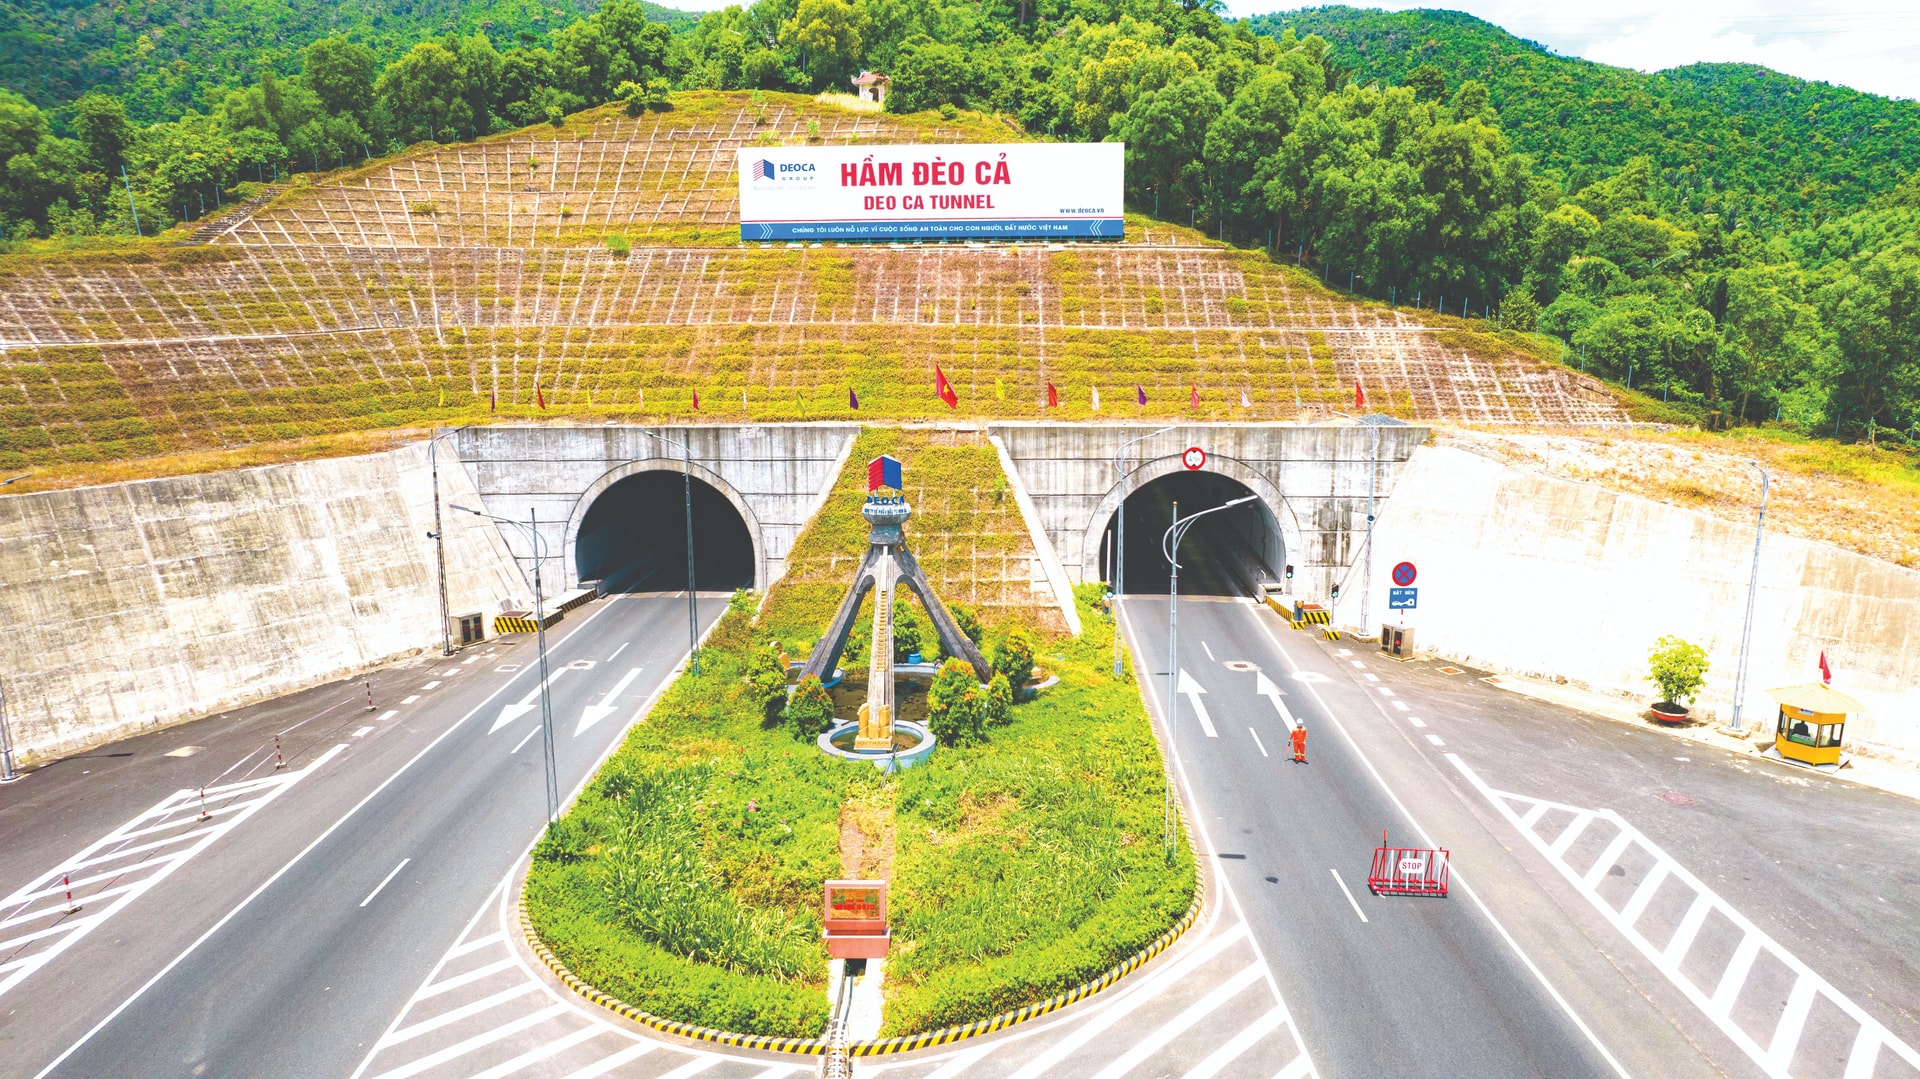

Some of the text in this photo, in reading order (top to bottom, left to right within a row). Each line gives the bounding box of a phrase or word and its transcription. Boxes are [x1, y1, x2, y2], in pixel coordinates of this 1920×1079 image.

[780, 163, 816, 173] DEOCA
[841, 152, 1011, 187] HẦM ĐÈO CẢ
[864, 194, 995, 211] DEO CA TUNNEL
[828, 225, 845, 233] LUÔN
[867, 495, 905, 506] DEOCA
[1401, 862, 1423, 870] STOP
